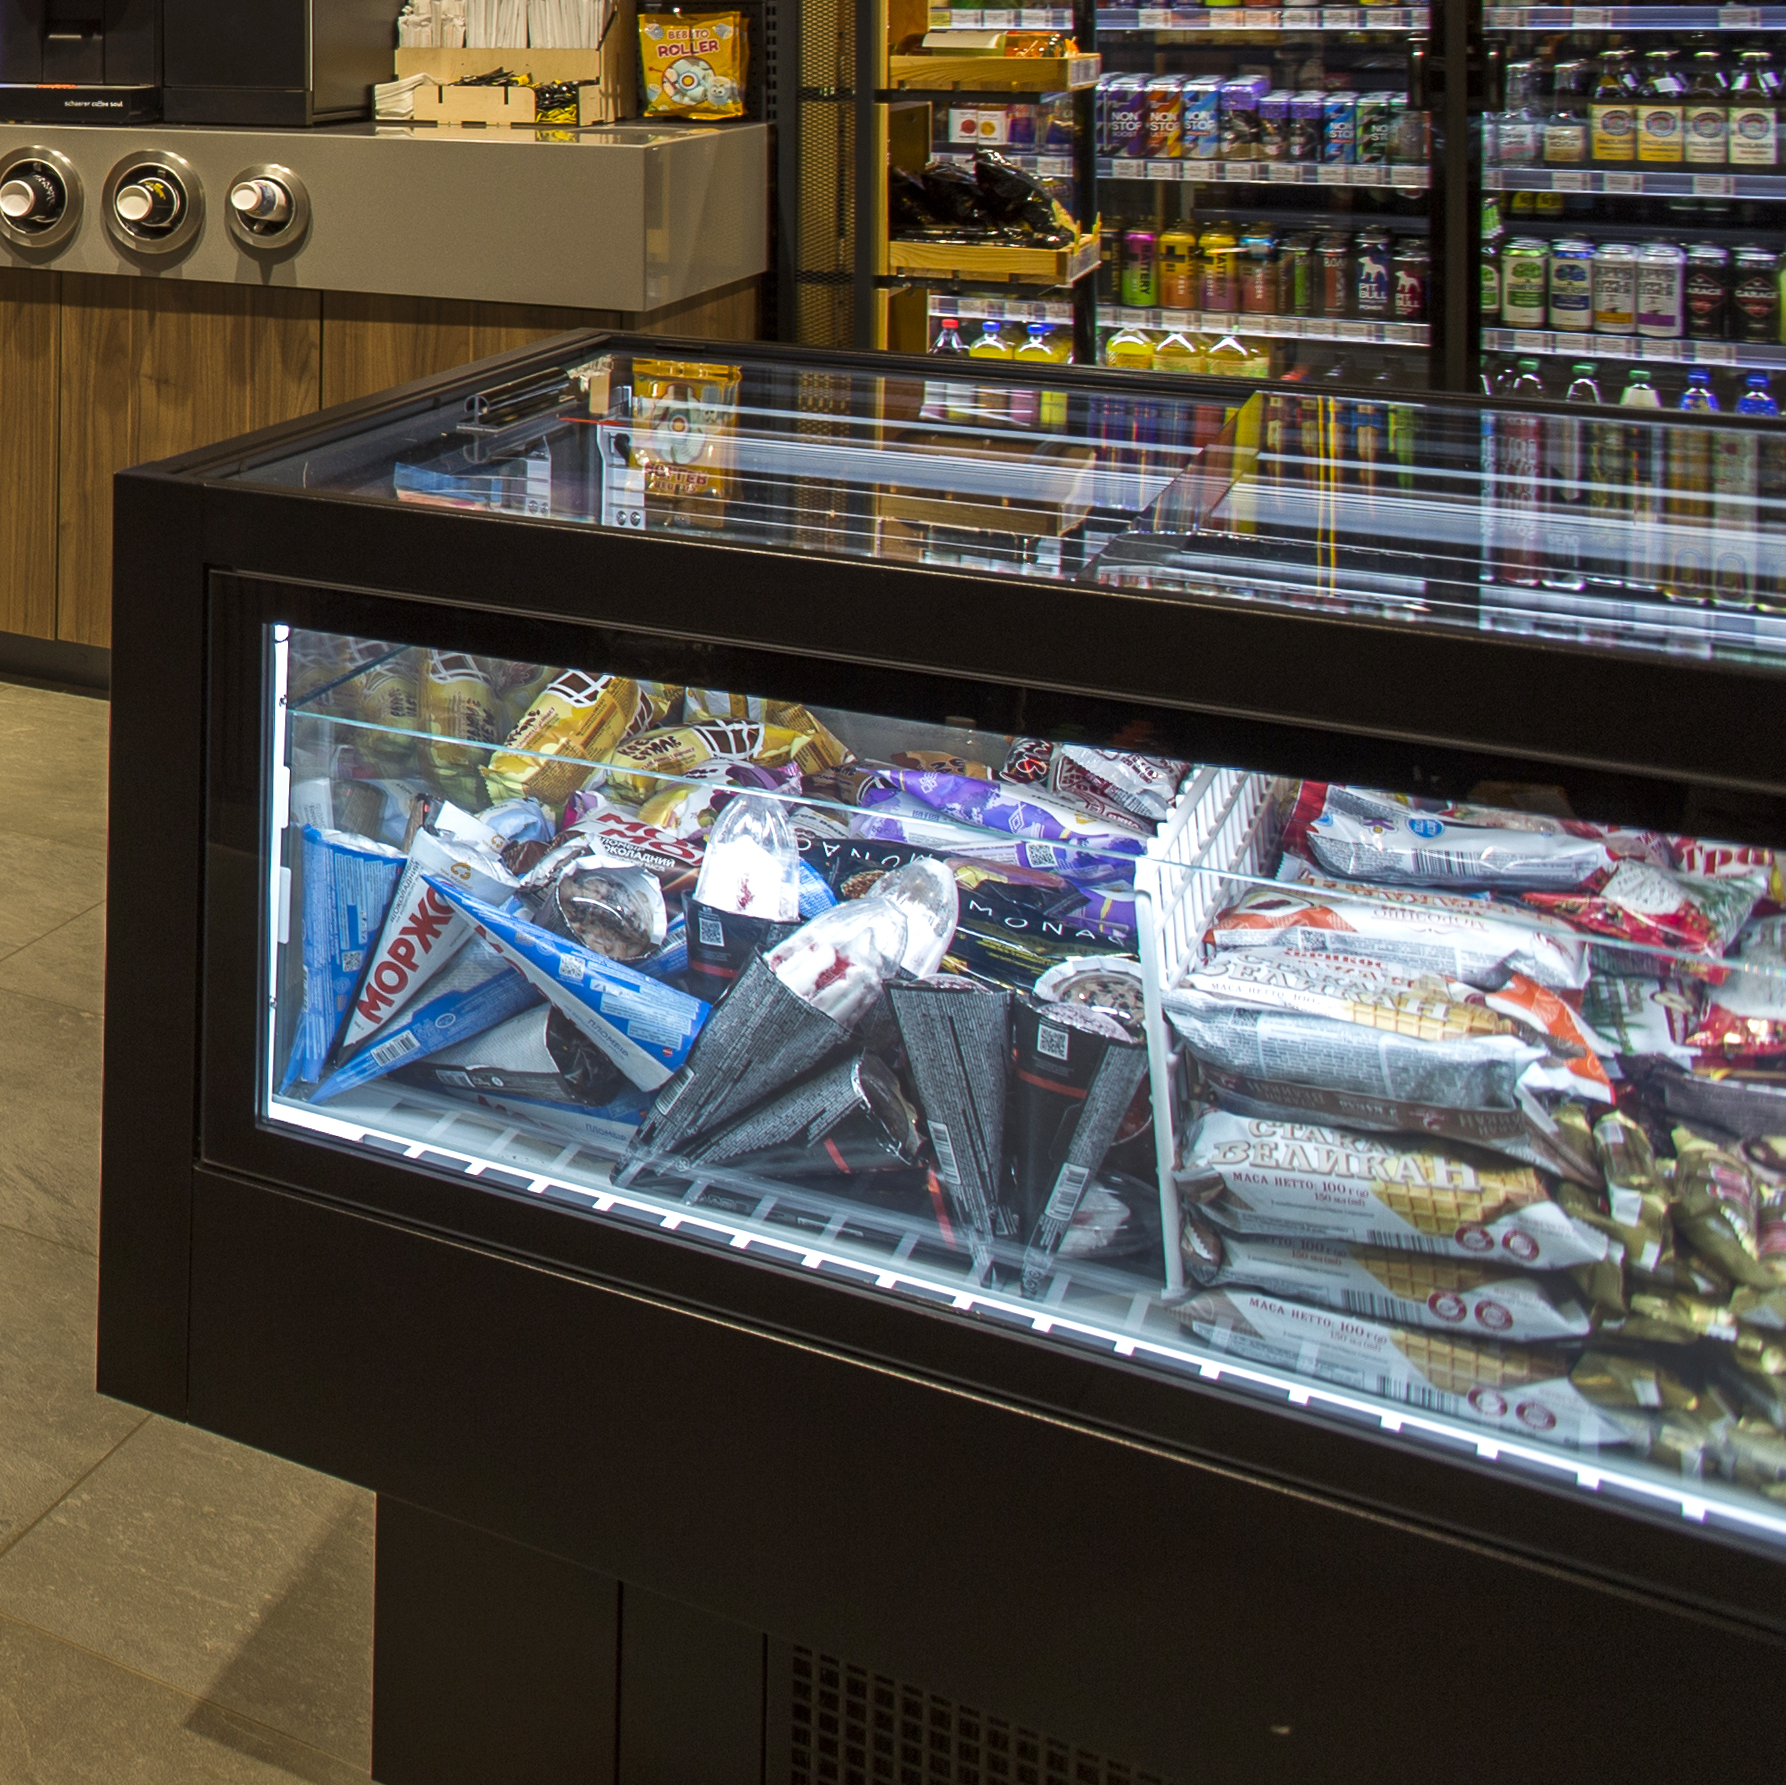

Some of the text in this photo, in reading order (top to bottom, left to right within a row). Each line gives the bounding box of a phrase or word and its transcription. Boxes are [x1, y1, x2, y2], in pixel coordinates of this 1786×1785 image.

[657, 40, 720, 58] ROLLER
[1111, 111, 1138, 121] NON
[1149, 111, 1178, 121] NON
[1140, 244, 1151, 297] BATTERY
[1358, 282, 1378, 292] PIT
[1358, 289, 1387, 300] BULL
[602, 843, 677, 870] ОКОЛАДНИЙ
[1247, 1118, 1395, 1154] СТАКА
[1211, 1140, 1484, 1193] ВЕЛИКАН
[1232, 1171, 1271, 1188] МАСА
[1274, 1177, 1317, 1191] НЕТТО:
[1321, 1181, 1345, 1194] 100
[1313, 1191, 1331, 1202] 150
[1249, 1296, 1284, 1316] МАСА
[1290, 1305, 1337, 1329] НЕТТО:
[1339, 1320, 1365, 1338] 100
